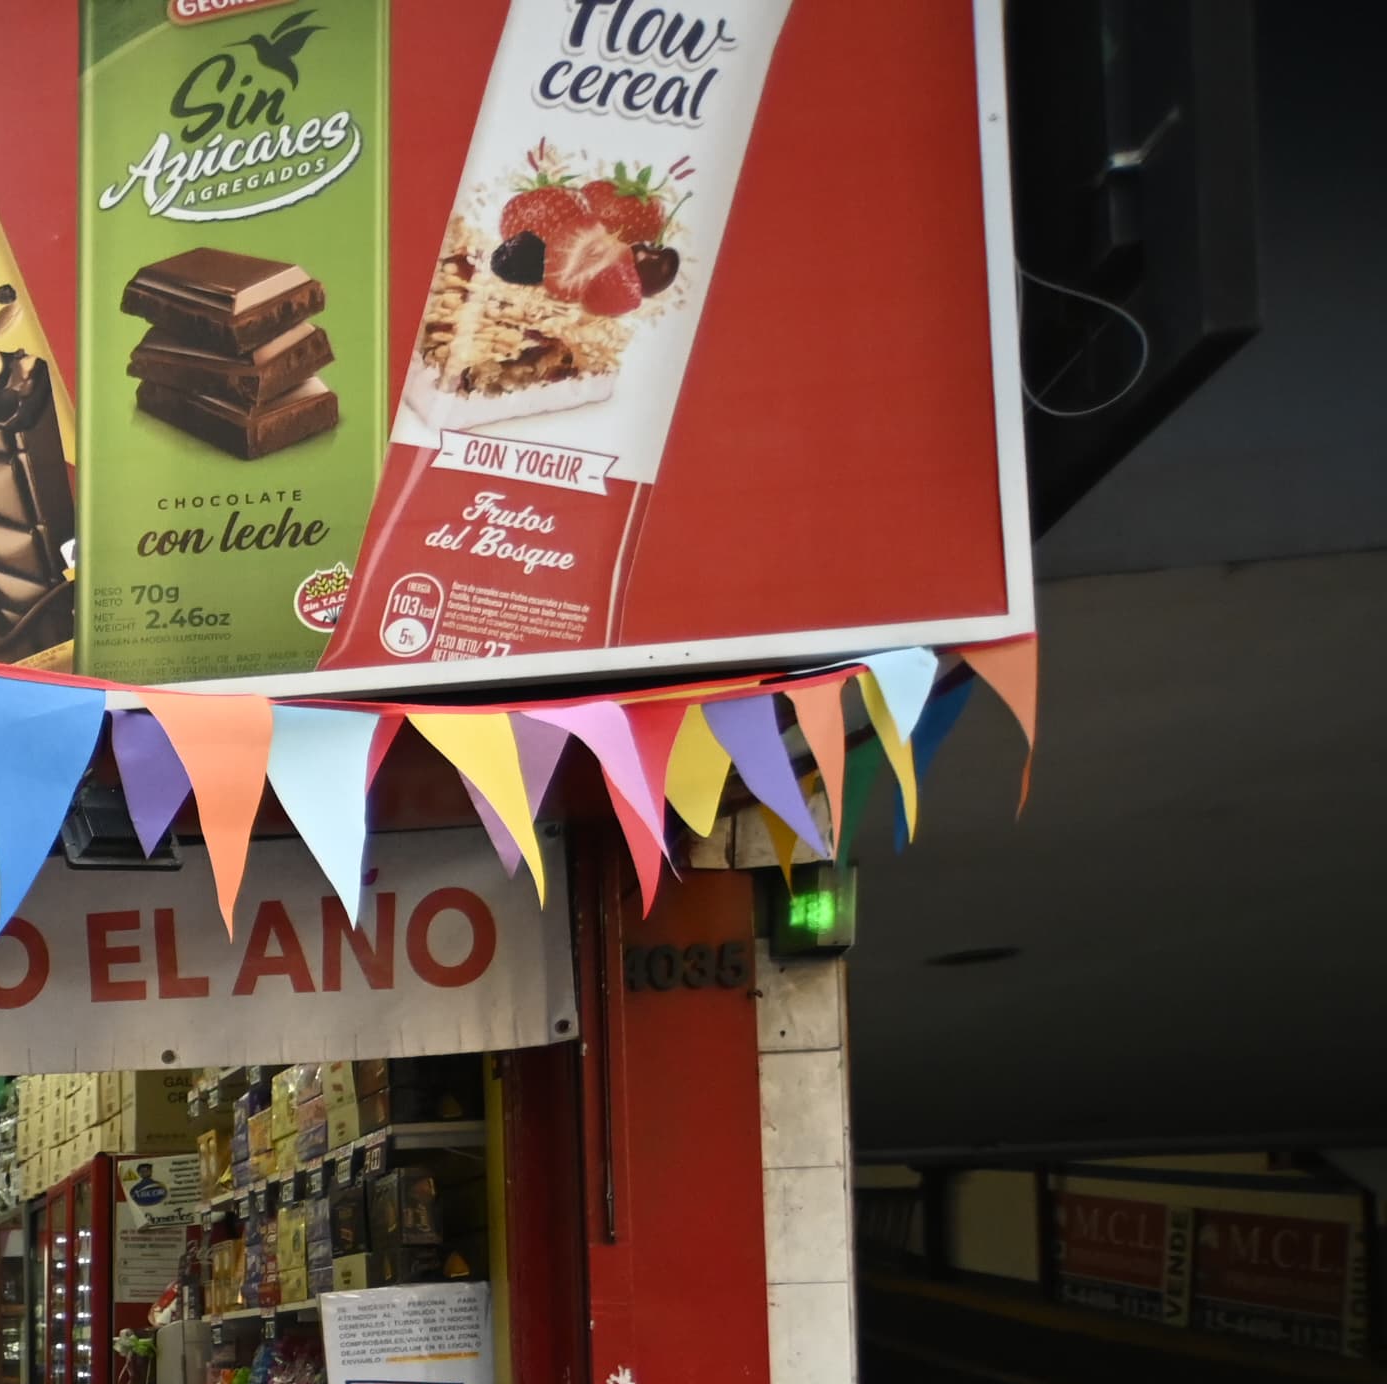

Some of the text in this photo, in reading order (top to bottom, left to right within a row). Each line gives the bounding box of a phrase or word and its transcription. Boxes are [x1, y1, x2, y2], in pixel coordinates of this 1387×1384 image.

[170, 53, 285, 143] Sin
[538, 56, 720, 120] cereal
[99, 111, 351, 212] Azúcares
[183, 157, 326, 205] AGREGADOS
[464, 440, 582, 484] CON YOGUR
[157, 489, 303, 511] CHOCOLATE
[463, 490, 556, 534] Frutos
[138, 510, 331, 557] con leche
[425, 524, 575, 574] del Bosque
[94, 584, 180, 605] PESO 70g
[94, 598, 123, 607] NETO
[393, 594, 437, 620] 103 kcal
[94, 608, 230, 630] NET 2.46oz
[86, 908, 208, 1002] EL
[1165, 1212, 1190, 1320] VENDE
